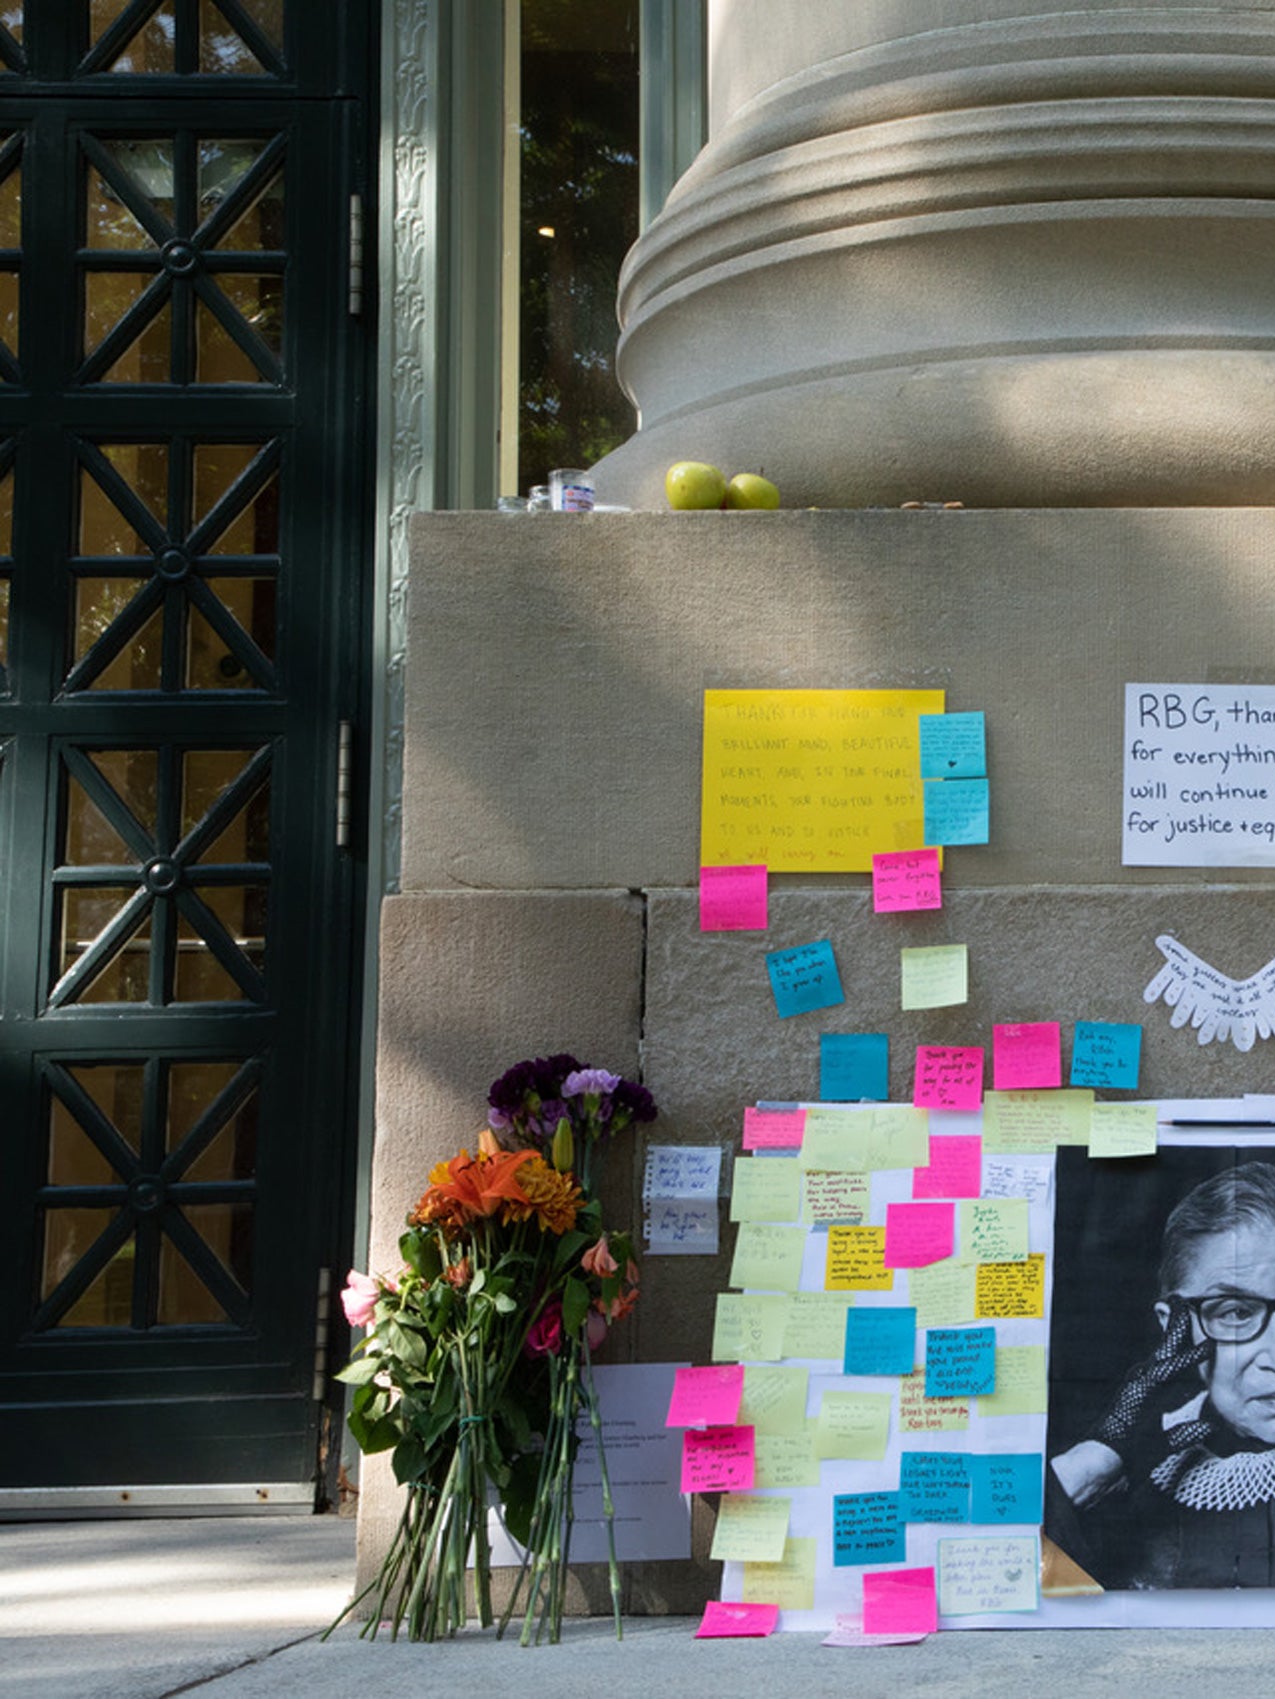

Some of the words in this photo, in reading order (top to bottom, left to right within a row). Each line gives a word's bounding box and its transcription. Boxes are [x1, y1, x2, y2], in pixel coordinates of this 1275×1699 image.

[1139, 694, 1220, 732] RBG,
[721, 737, 789, 752] BRILLIANT
[1131, 739, 1161, 761] for
[1130, 780, 1166, 799] will
[1179, 783, 1267, 803] continue
[1127, 812, 1158, 832] for
[1164, 813, 1232, 842] justice
[926, 1050, 946, 1060] Thank
[948, 1545, 979, 1555] Thank
[984, 1545, 999, 1555] you
[1004, 1544, 1019, 1556] for
